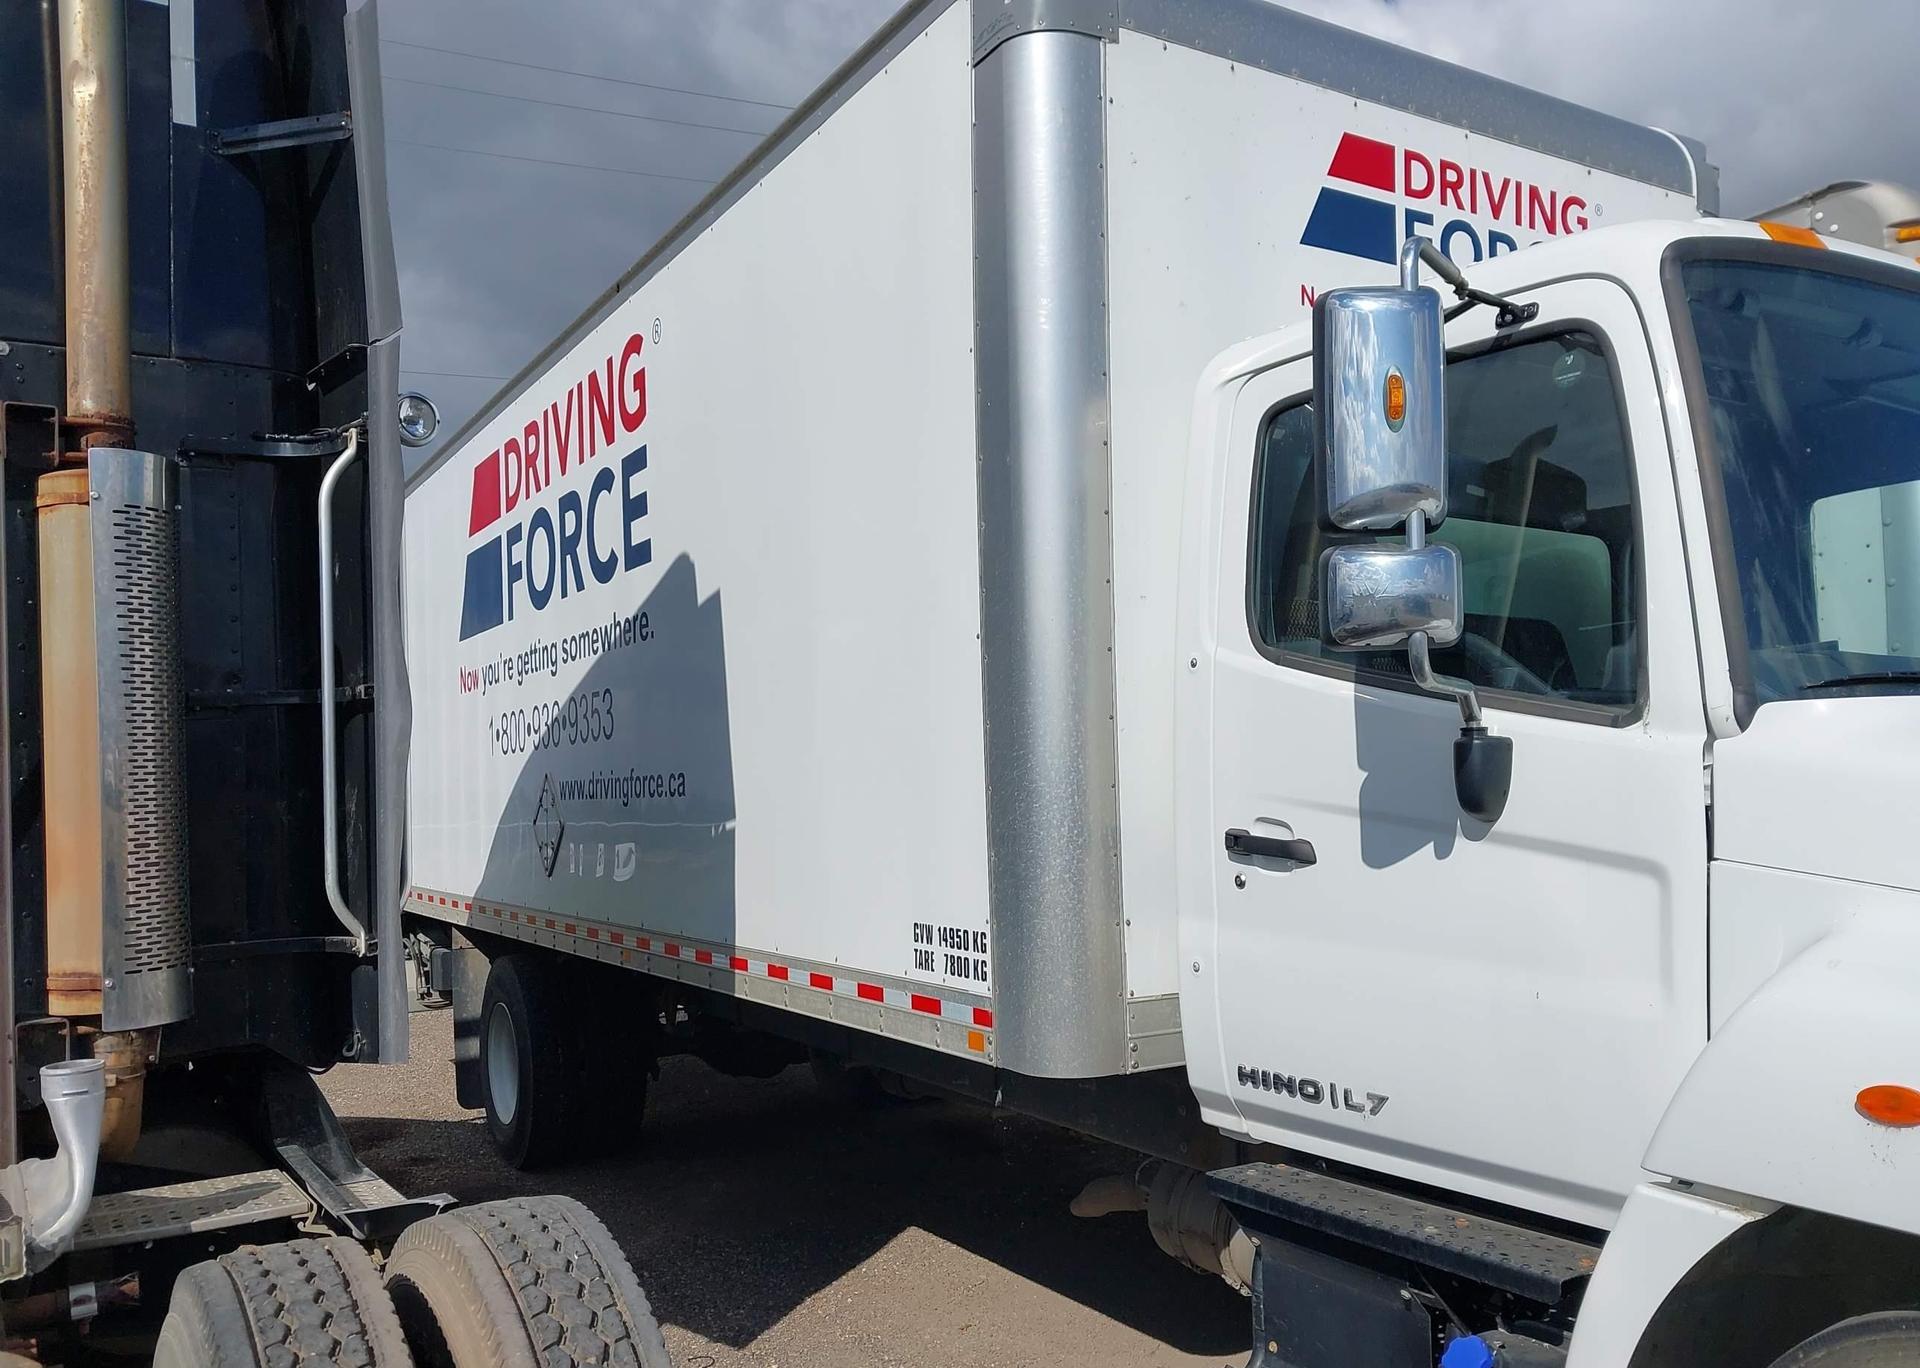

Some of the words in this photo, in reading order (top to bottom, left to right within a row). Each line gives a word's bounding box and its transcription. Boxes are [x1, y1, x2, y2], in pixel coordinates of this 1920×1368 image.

[1404, 148, 1588, 236] DRIVING
[504, 333, 647, 514] DRIVING
[506, 444, 652, 621] FORCE
[460, 666, 479, 694] Now
[482, 652, 514, 696] you're
[516, 638, 558, 686] getting
[561, 611, 655, 664] somewhere.
[559, 768, 686, 807] www.drivingforce.ca
[913, 922, 933, 945] GVW
[938, 926, 969, 951] 14950
[973, 930, 987, 954] KG
[913, 948, 935, 972] TARE
[944, 954, 970, 979] 7800
[973, 959, 987, 982] KG
[1237, 1064, 1325, 1105] HINO
[1344, 1087, 1389, 1116] L7
